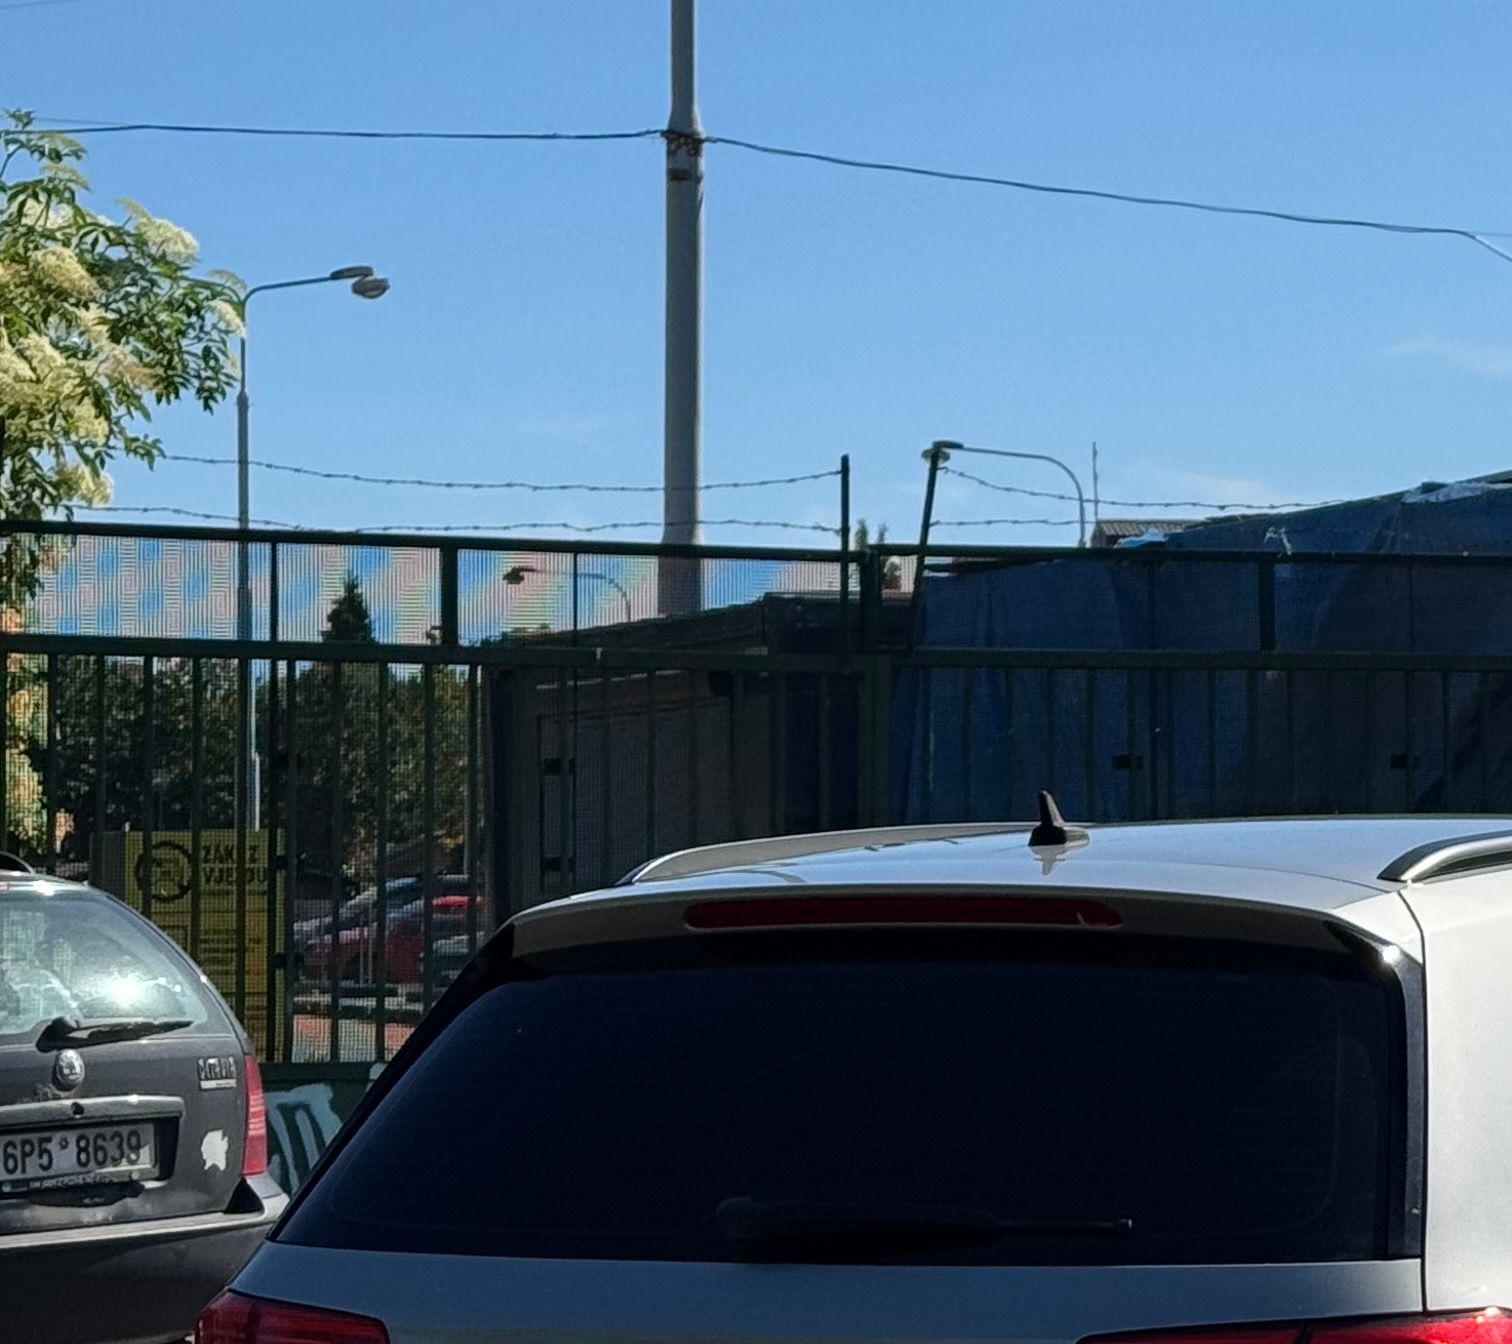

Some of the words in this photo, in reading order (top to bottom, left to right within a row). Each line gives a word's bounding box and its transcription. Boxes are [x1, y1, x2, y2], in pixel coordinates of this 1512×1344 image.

[201, 844, 258, 865] ZÁKZ
[2, 1135, 54, 1176] 6P5
[76, 1128, 142, 1169] 8639
